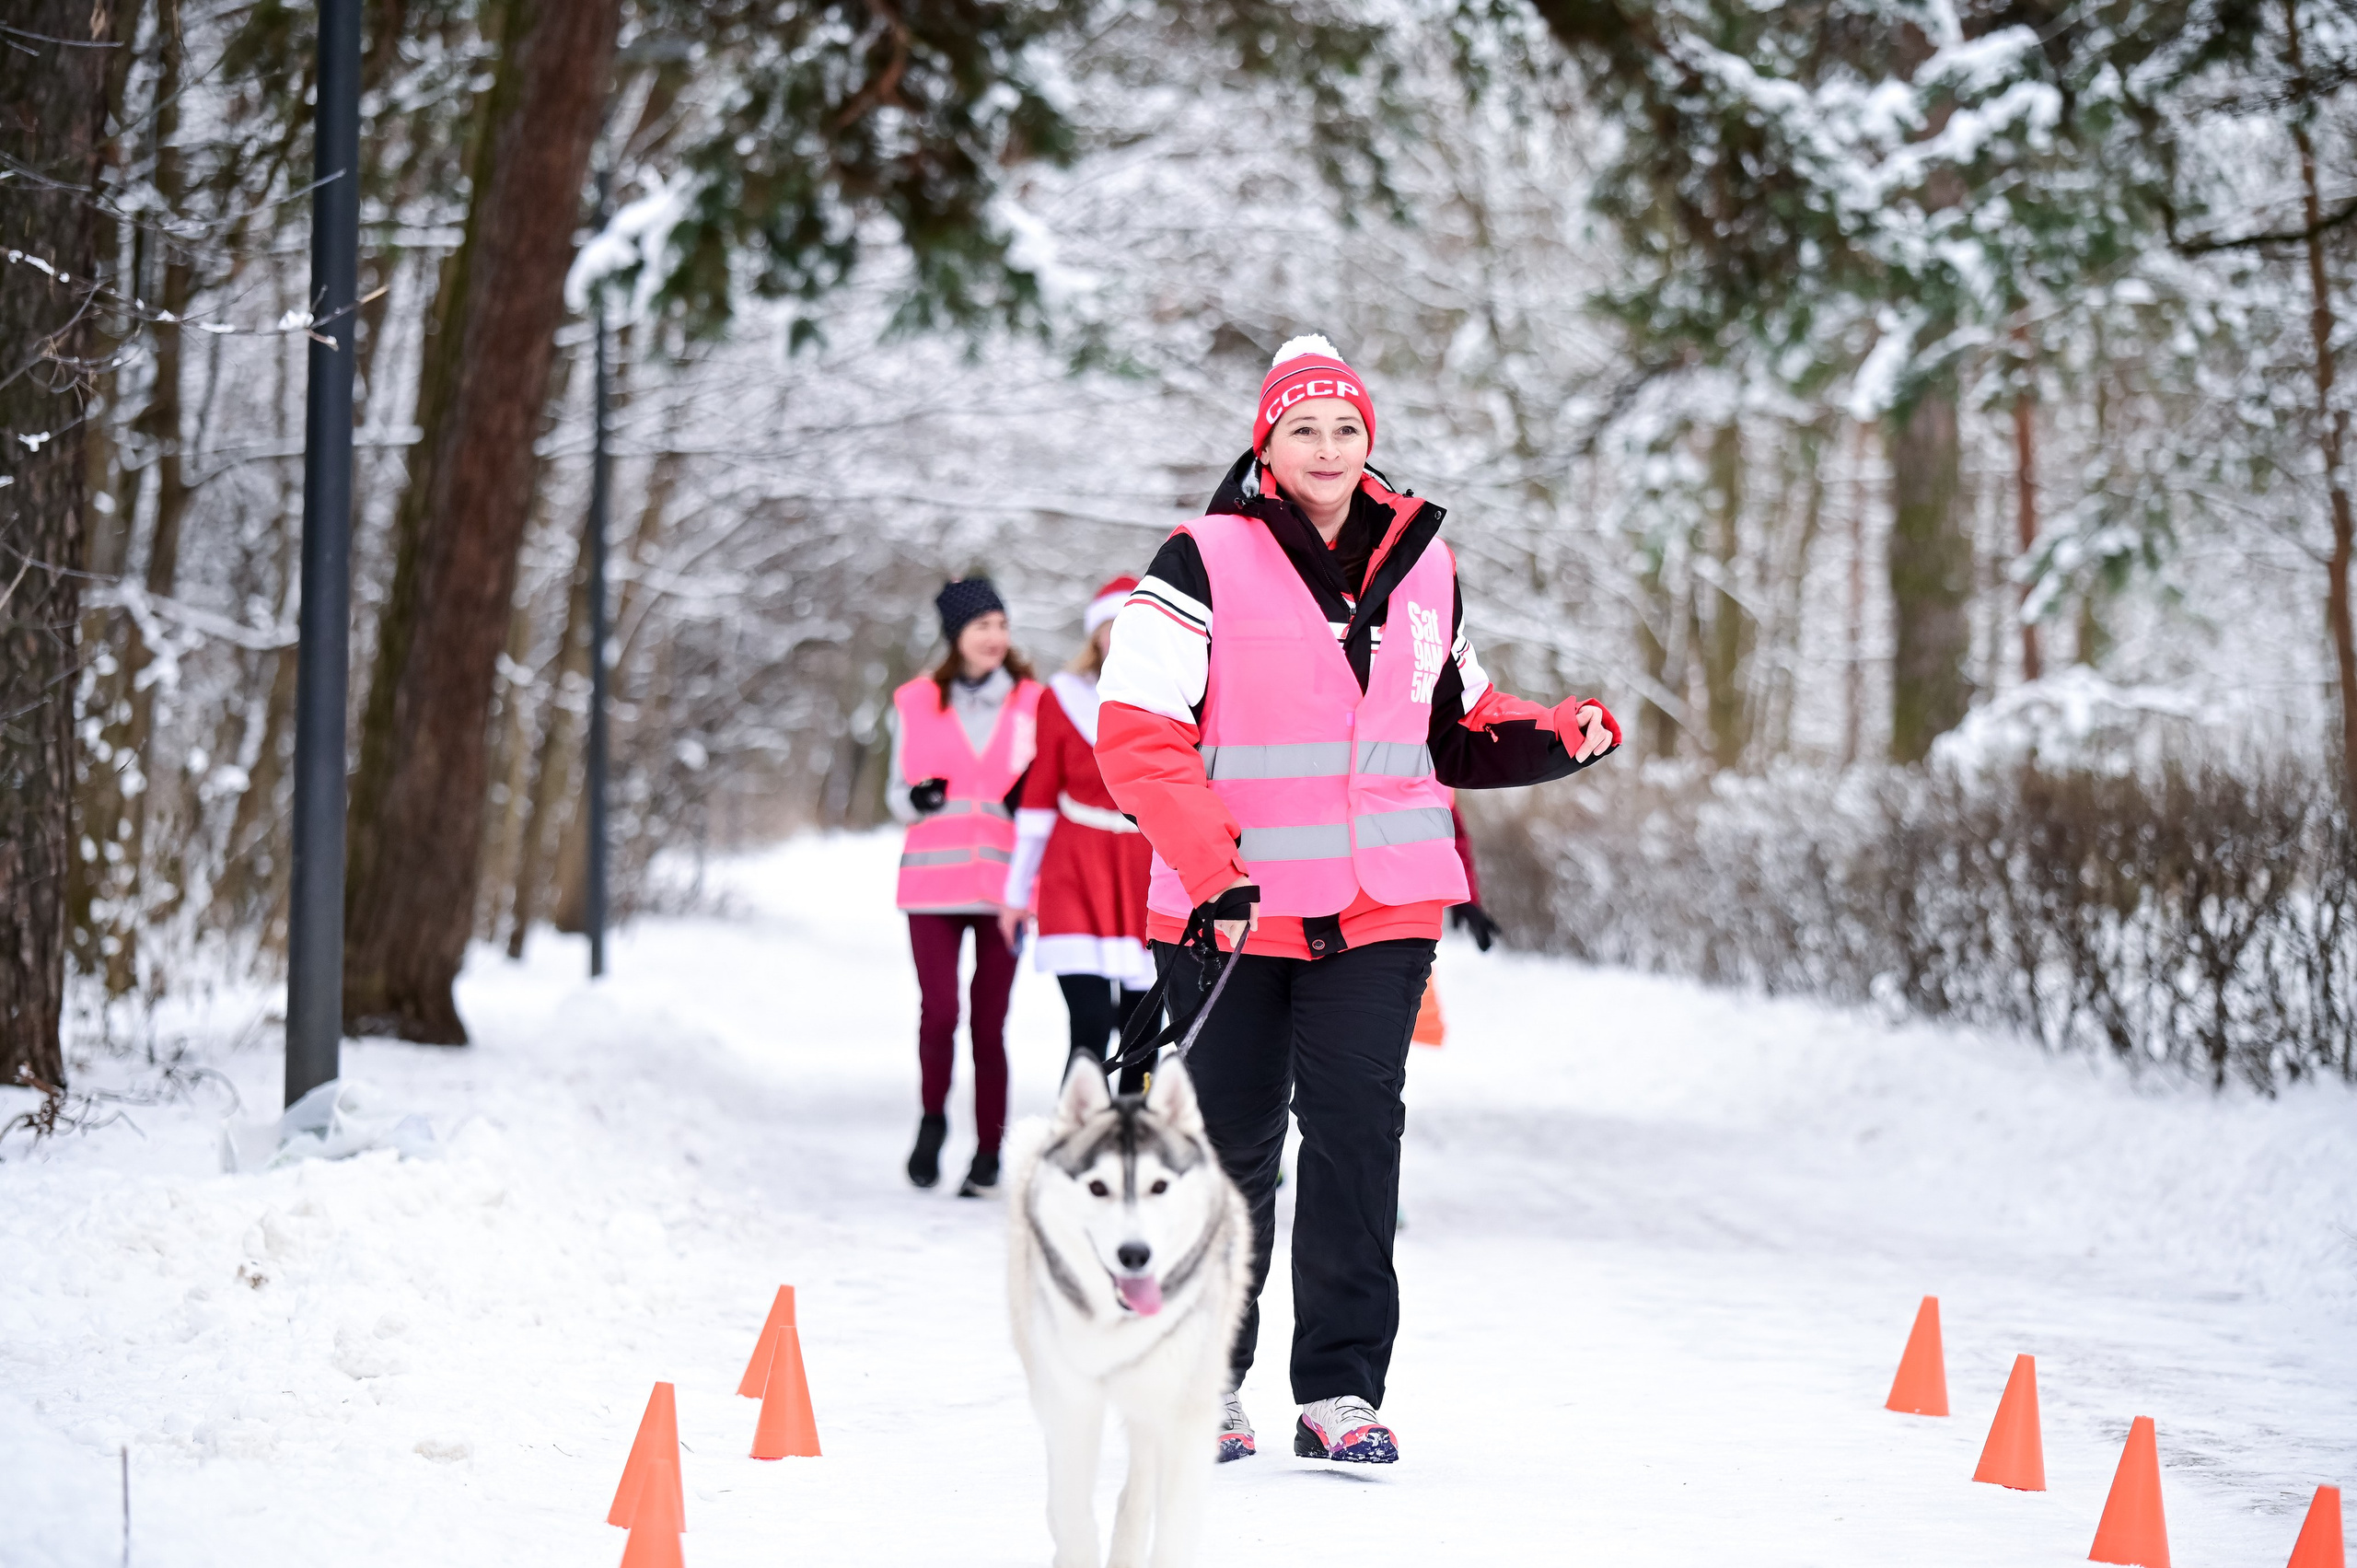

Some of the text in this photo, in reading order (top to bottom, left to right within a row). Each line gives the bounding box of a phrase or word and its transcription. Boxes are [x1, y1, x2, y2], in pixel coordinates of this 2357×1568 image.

[1266, 380, 1359, 424] СССР
[1407, 601, 1443, 645] Sat
[1411, 671, 1438, 704] 5K
